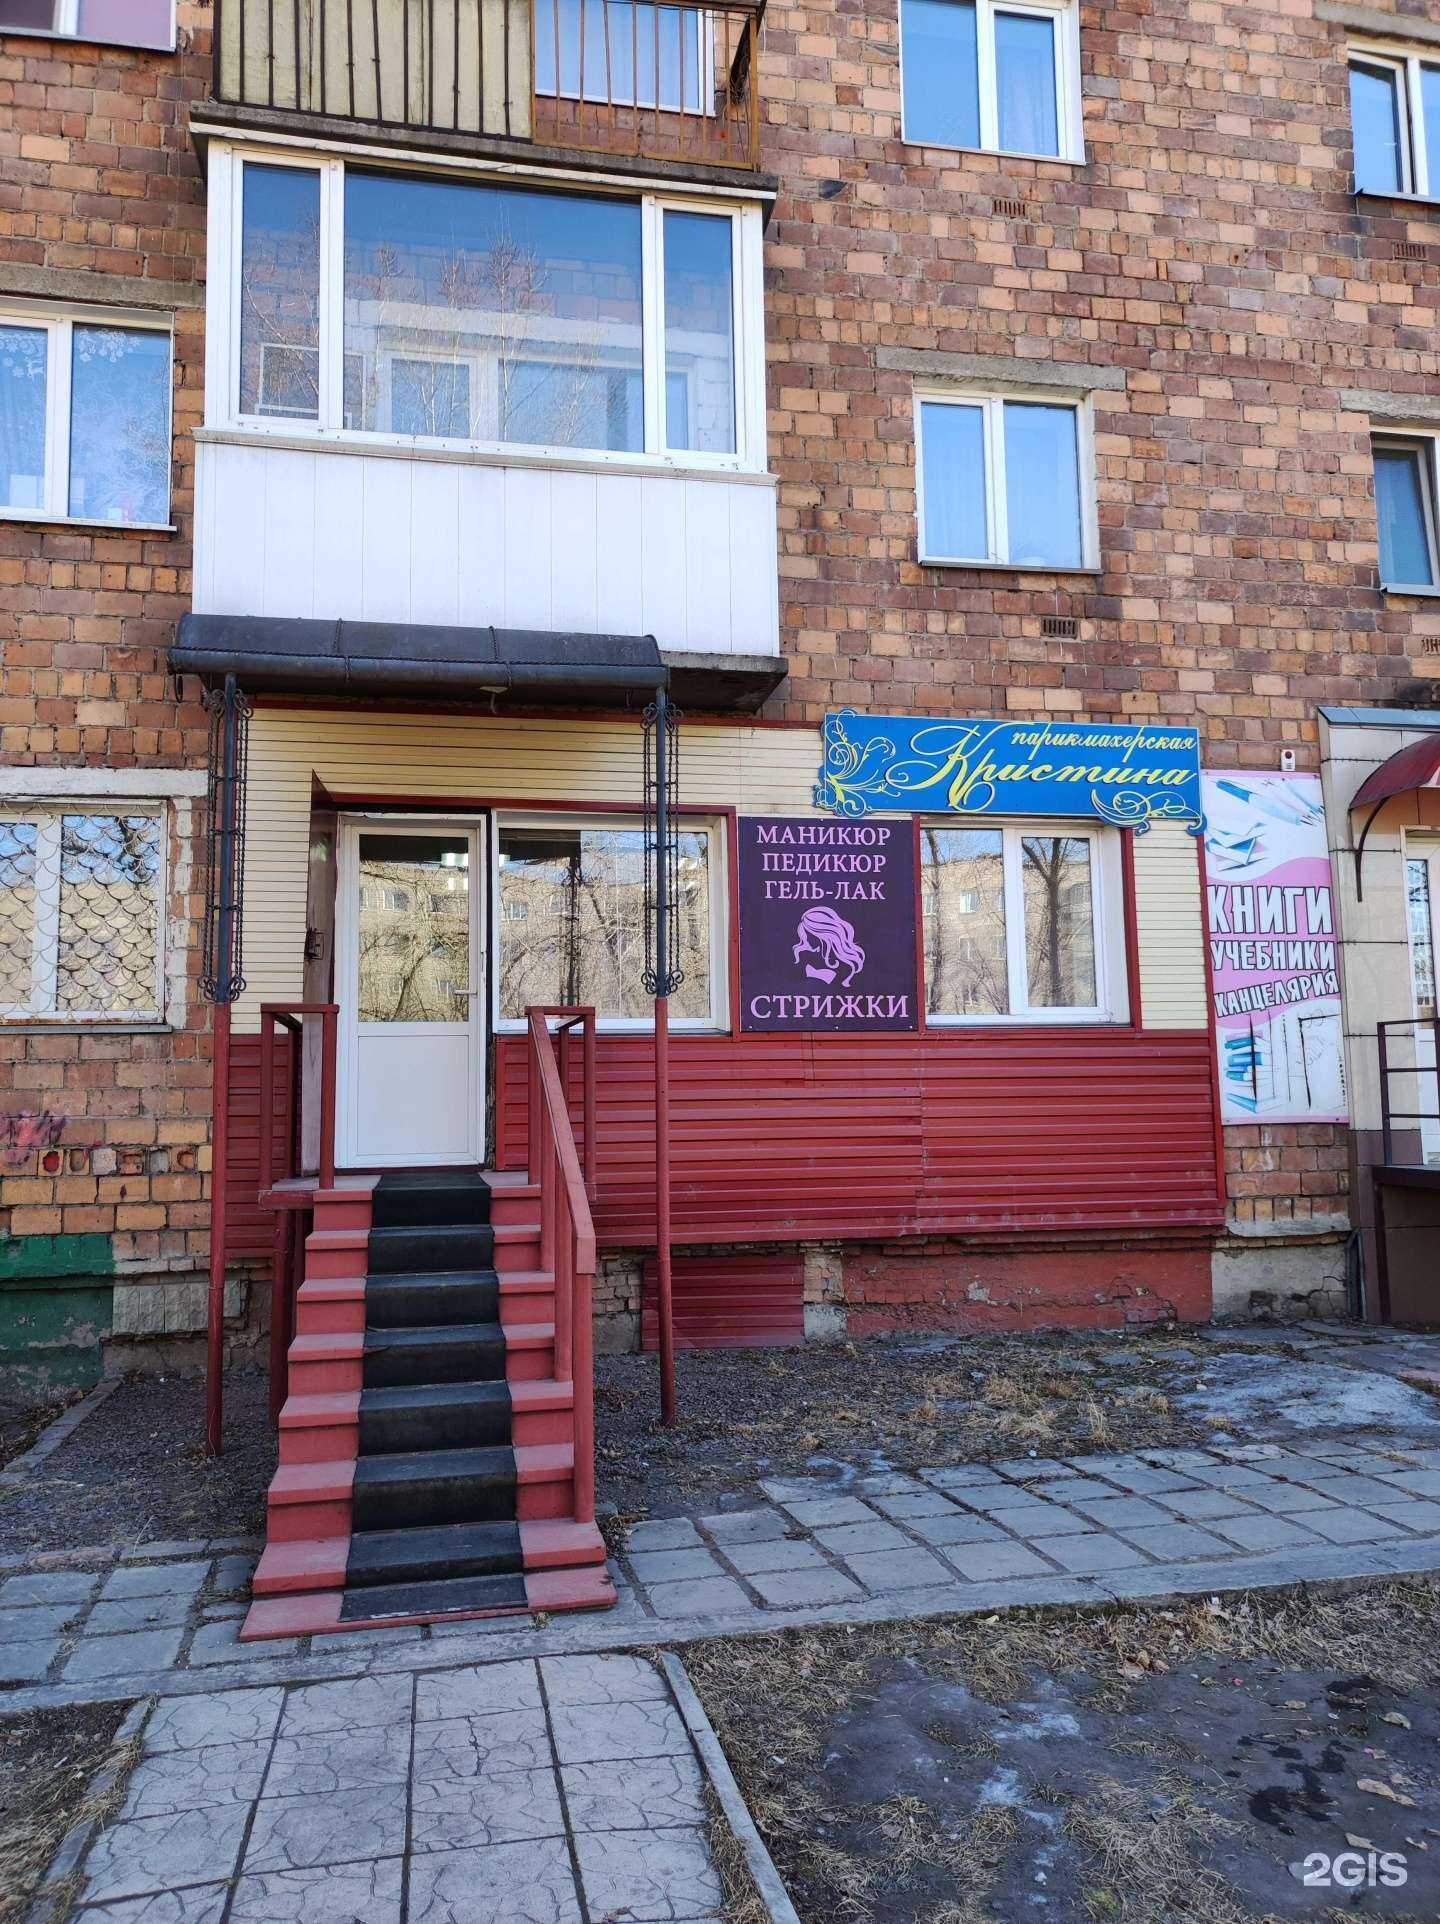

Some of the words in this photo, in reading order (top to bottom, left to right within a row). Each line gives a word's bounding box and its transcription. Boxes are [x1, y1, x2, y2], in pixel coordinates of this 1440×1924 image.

[1010, 723, 1199, 763] парикмахерская
[885, 723, 1199, 812] Кристина
[756, 825, 891, 846] МАНИКЮР
[761, 852, 887, 875] ПЕДИКЮР
[764, 880, 886, 900] ГЕЛЬ-ЛАК
[1206, 885, 1334, 934] КНИГИ
[1210, 940, 1336, 970] УЧЕБНИКИ
[750, 995, 909, 1019] СТРИЖКИ
[1213, 969, 1341, 1018] КАНЦЕЛЯРИЯ
